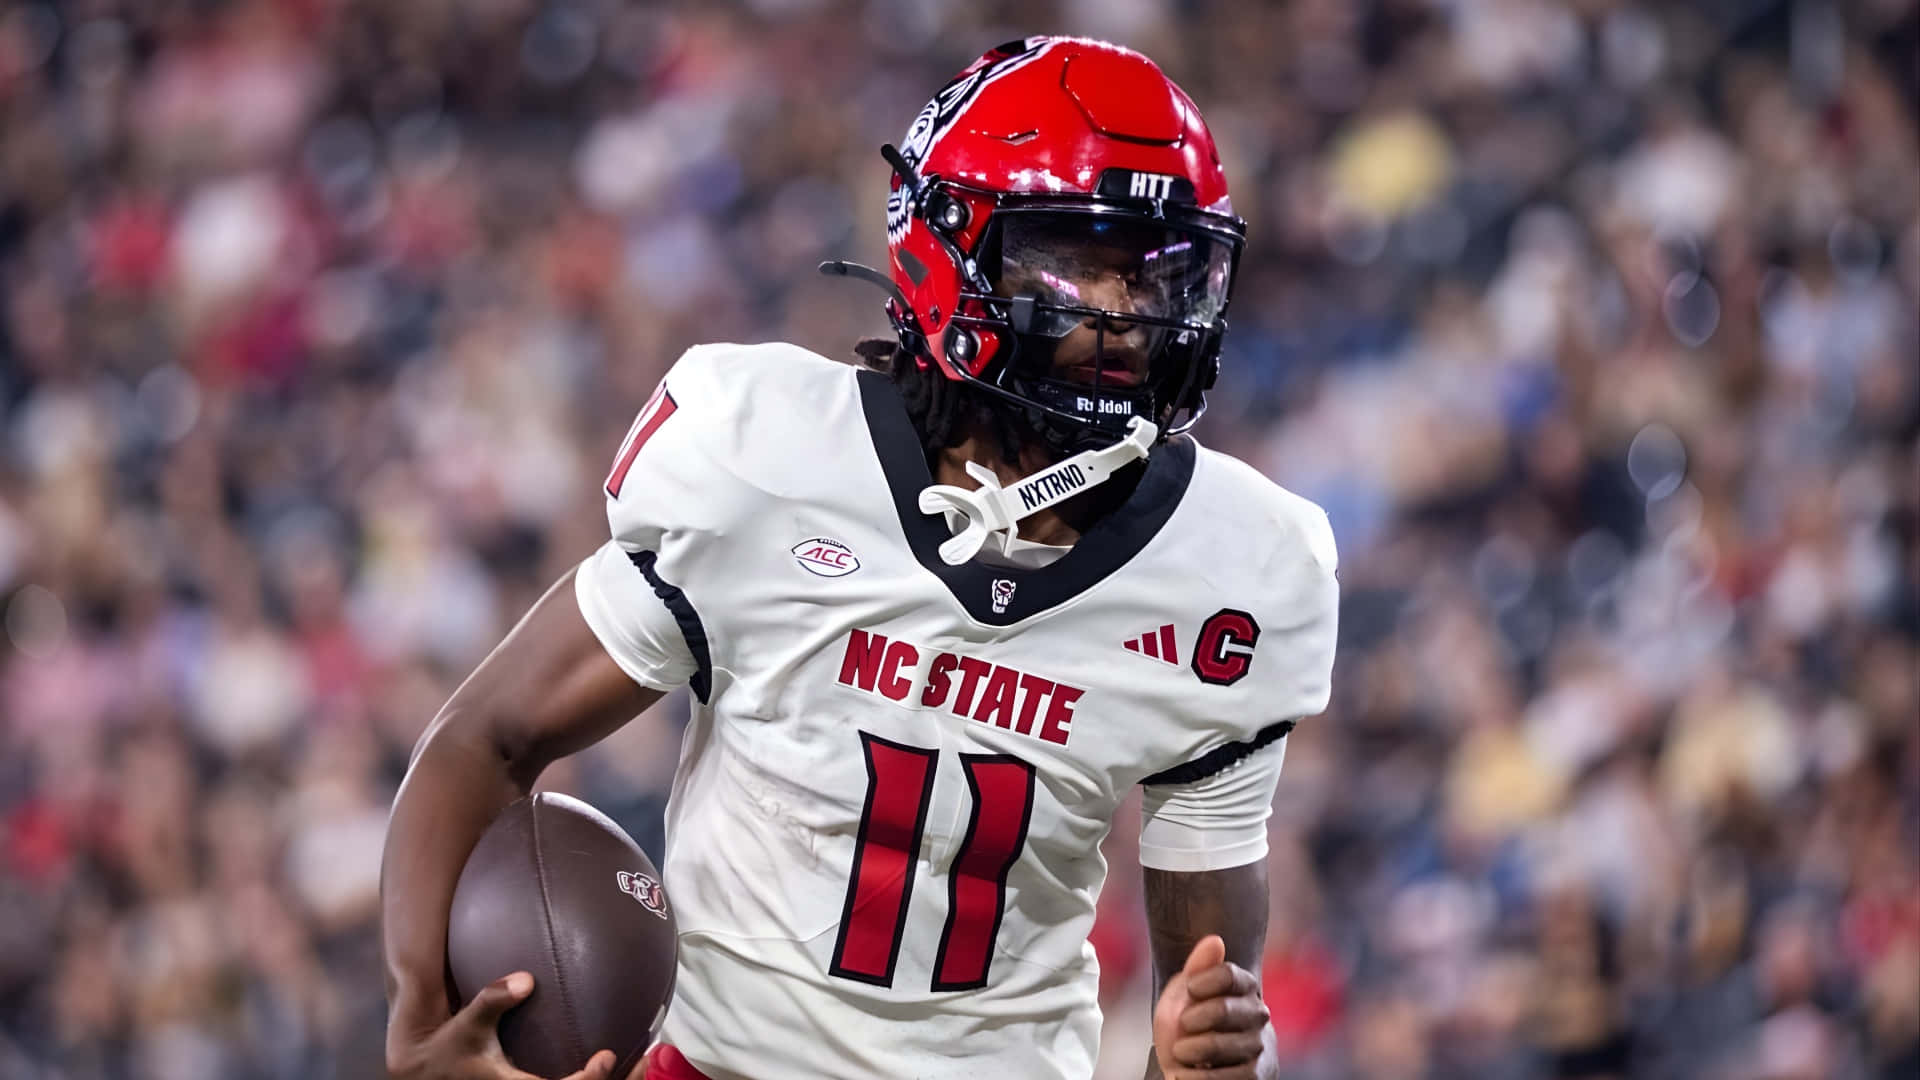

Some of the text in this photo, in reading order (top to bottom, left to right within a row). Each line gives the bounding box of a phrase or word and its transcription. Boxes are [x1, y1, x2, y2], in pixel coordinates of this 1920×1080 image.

[1130, 171, 1174, 200] HTT
[1018, 463, 1086, 511] NXTRND
[801, 547, 853, 567] ACC
[1191, 607, 1261, 687] C
[838, 627, 1087, 746] NC STATE
[828, 729, 1037, 993] 11
